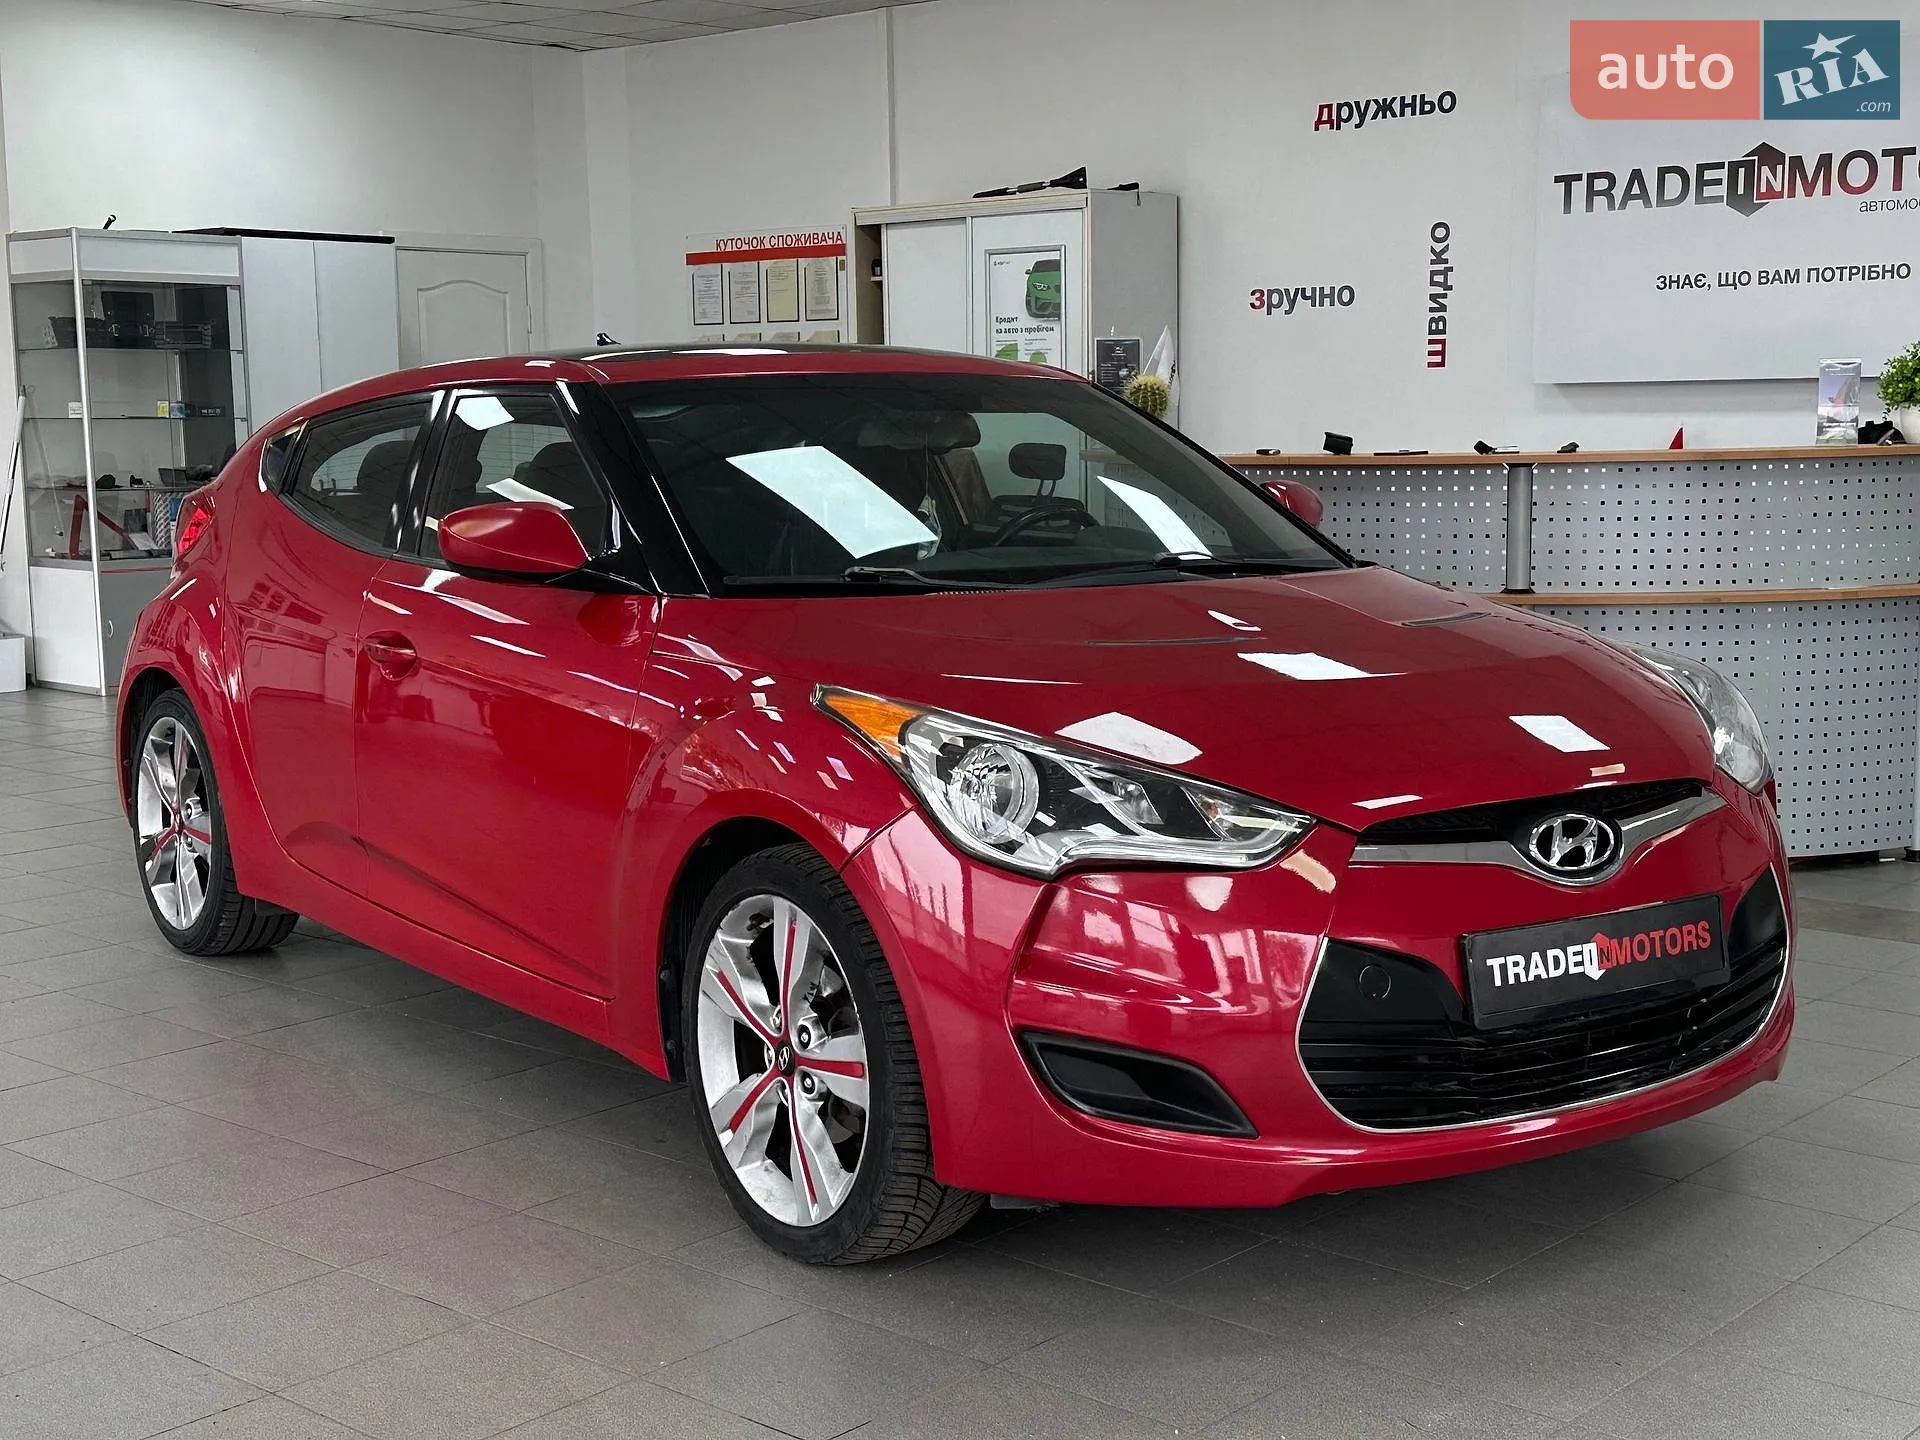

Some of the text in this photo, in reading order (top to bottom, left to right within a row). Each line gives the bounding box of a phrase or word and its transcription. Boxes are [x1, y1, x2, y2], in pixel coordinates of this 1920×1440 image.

[1314, 90, 1457, 131] дружньо
[1859, 197, 1920, 214] автомо
[715, 231, 843, 251] КУТОЧОК СПОЖИВАЧА
[1655, 262, 1912, 292] ЗНАЄ, ЩО ВАМ ПОТРІБНО
[1250, 285, 1355, 315] зручно
[1426, 221, 1453, 368] швидко
